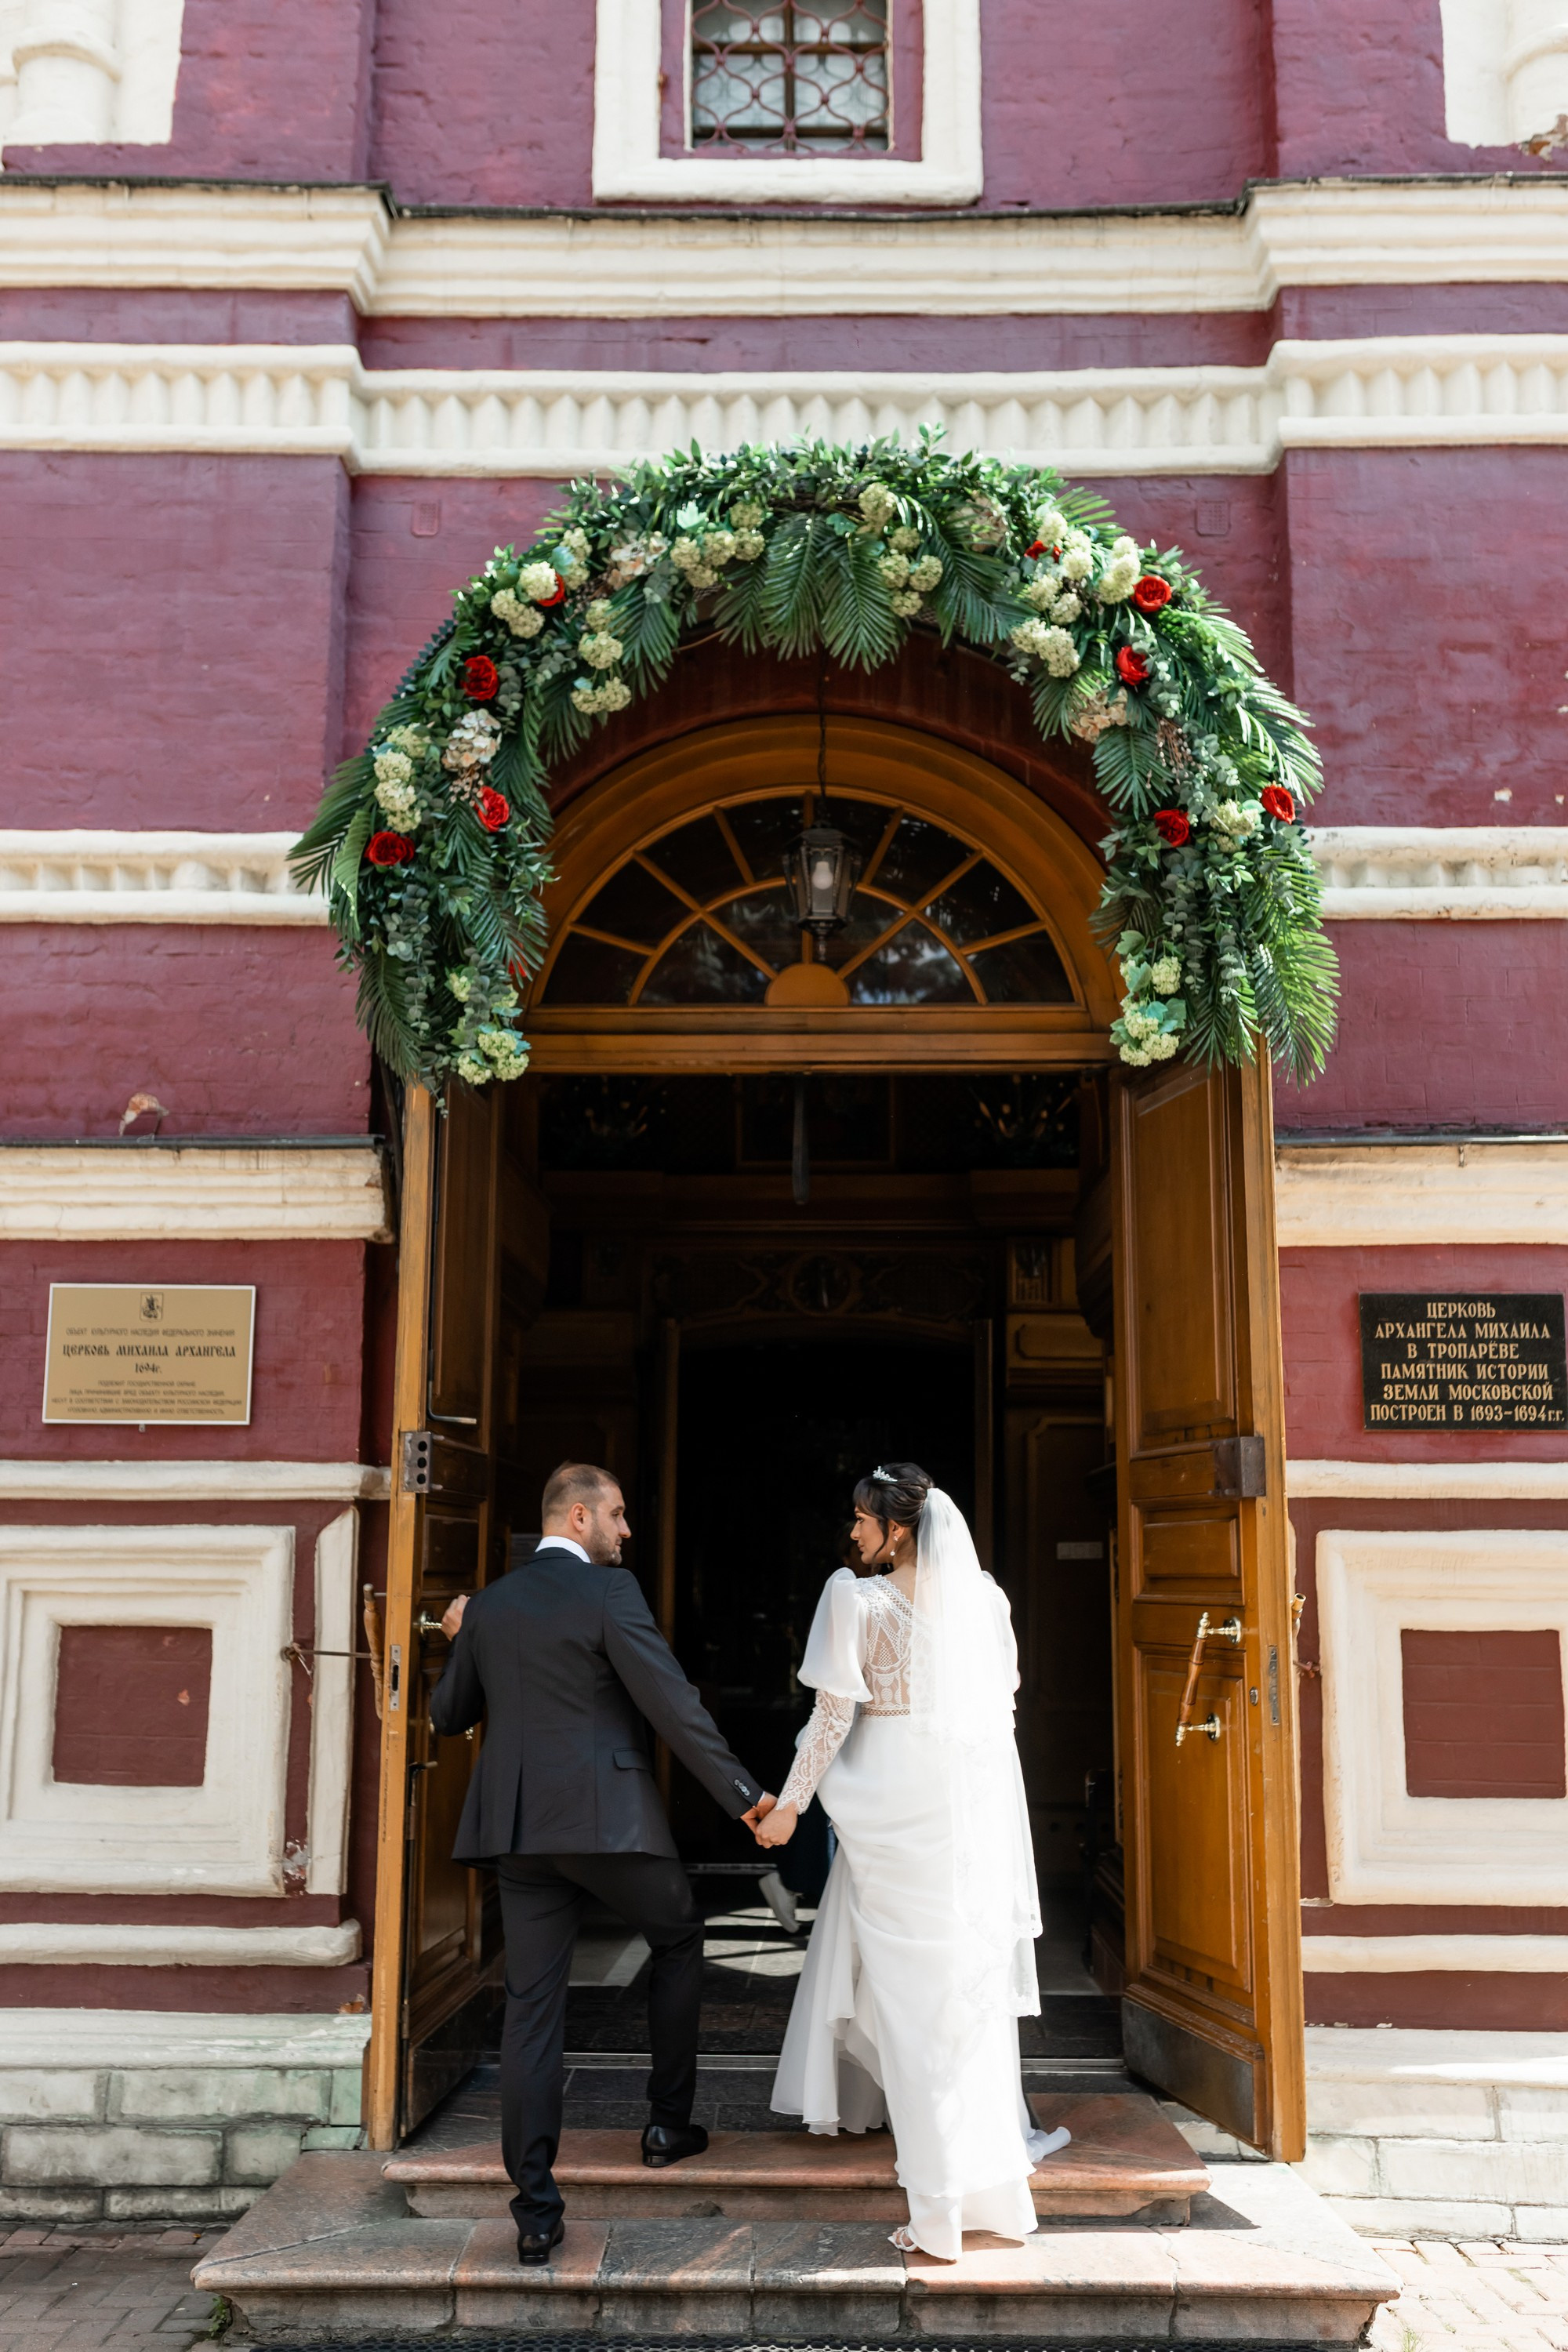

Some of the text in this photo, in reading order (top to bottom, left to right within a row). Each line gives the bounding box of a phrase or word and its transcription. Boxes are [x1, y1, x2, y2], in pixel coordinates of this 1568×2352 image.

[1427, 1302, 1496, 1319] ЦЕРКОВЬ
[1374, 1323, 1550, 1339] АРХАНГЕЛА МИХАИЛА
[63, 1345, 110, 1357] ЦЕРКОВЬ
[176, 1345, 236, 1357] АРХАНГЕЛА
[1407, 1341, 1519, 1359] В ТРОПАРЁВЕ
[1381, 1363, 1548, 1380] ПАМЯТНИК ИСТОРИИ
[1383, 1381, 1553, 1400] ЗЕМЛИ МОСКОВСКОЙ
[1370, 1404, 1446, 1421] ПОСТРОЕН
[1454, 1406, 1463, 1421] В
